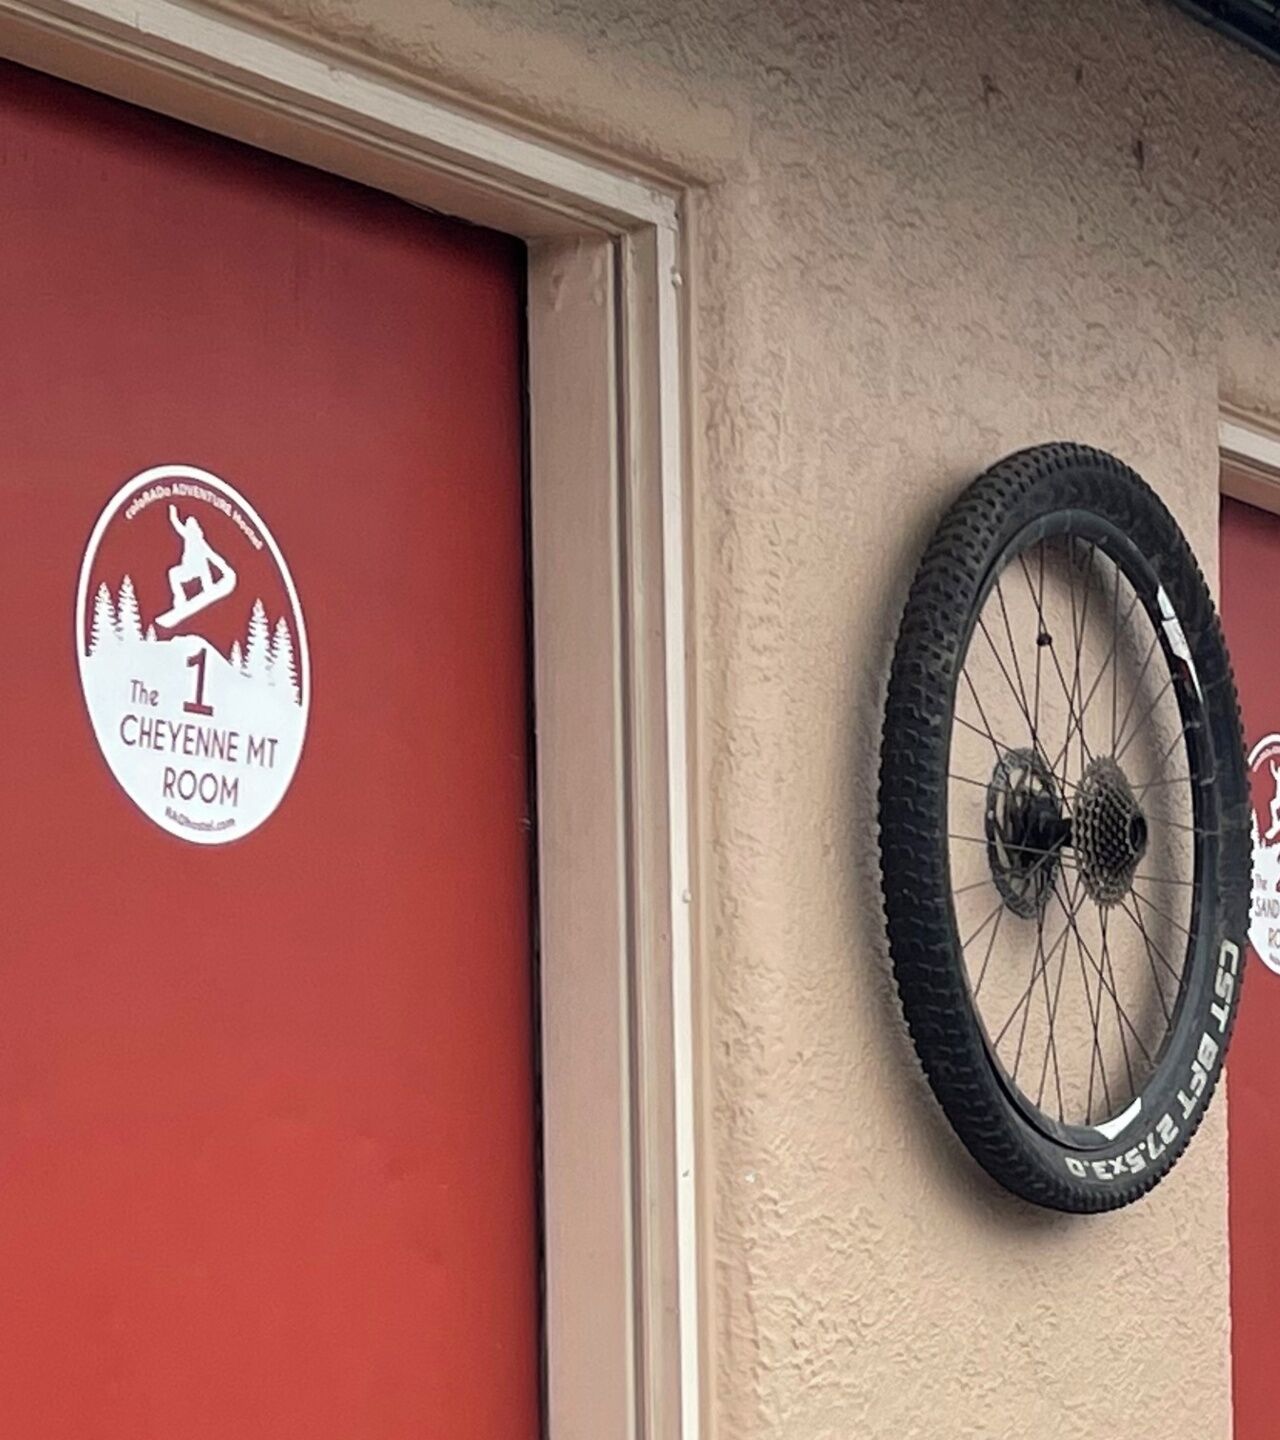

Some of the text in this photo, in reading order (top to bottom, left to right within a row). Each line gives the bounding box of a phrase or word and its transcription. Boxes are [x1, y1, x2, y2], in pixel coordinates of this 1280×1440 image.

[172, 483, 232, 517] ADVENTURE
[130, 679, 159, 707] The
[183, 647, 214, 717] 1
[119, 714, 279, 769] CHEYENNE MT
[163, 766, 240, 808] ROOM
[1254, 896, 1280, 919] SAND
[1210, 938, 1240, 1034] CST
